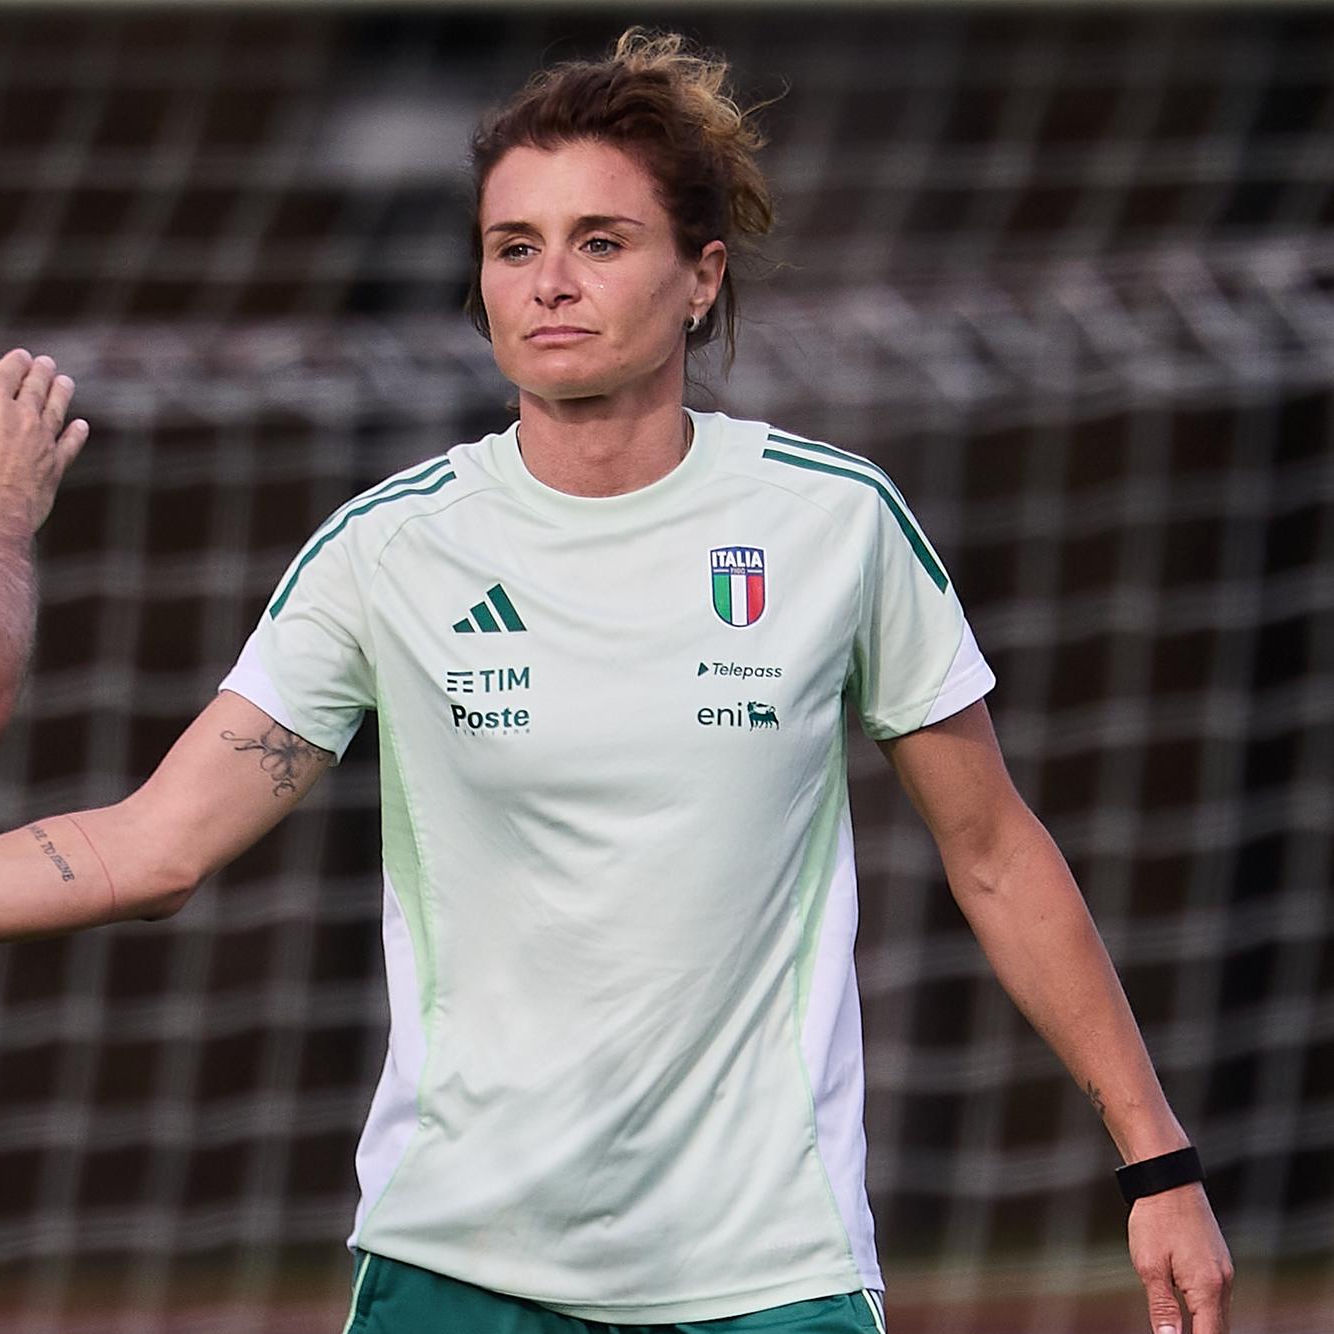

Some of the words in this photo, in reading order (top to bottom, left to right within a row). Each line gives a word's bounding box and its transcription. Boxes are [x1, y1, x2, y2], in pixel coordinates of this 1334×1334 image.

[712, 551, 763, 568] ITALIA
[479, 666, 530, 693] TIM
[712, 661, 783, 680] Telepass
[450, 704, 530, 729] Poste
[697, 702, 742, 727] eni
